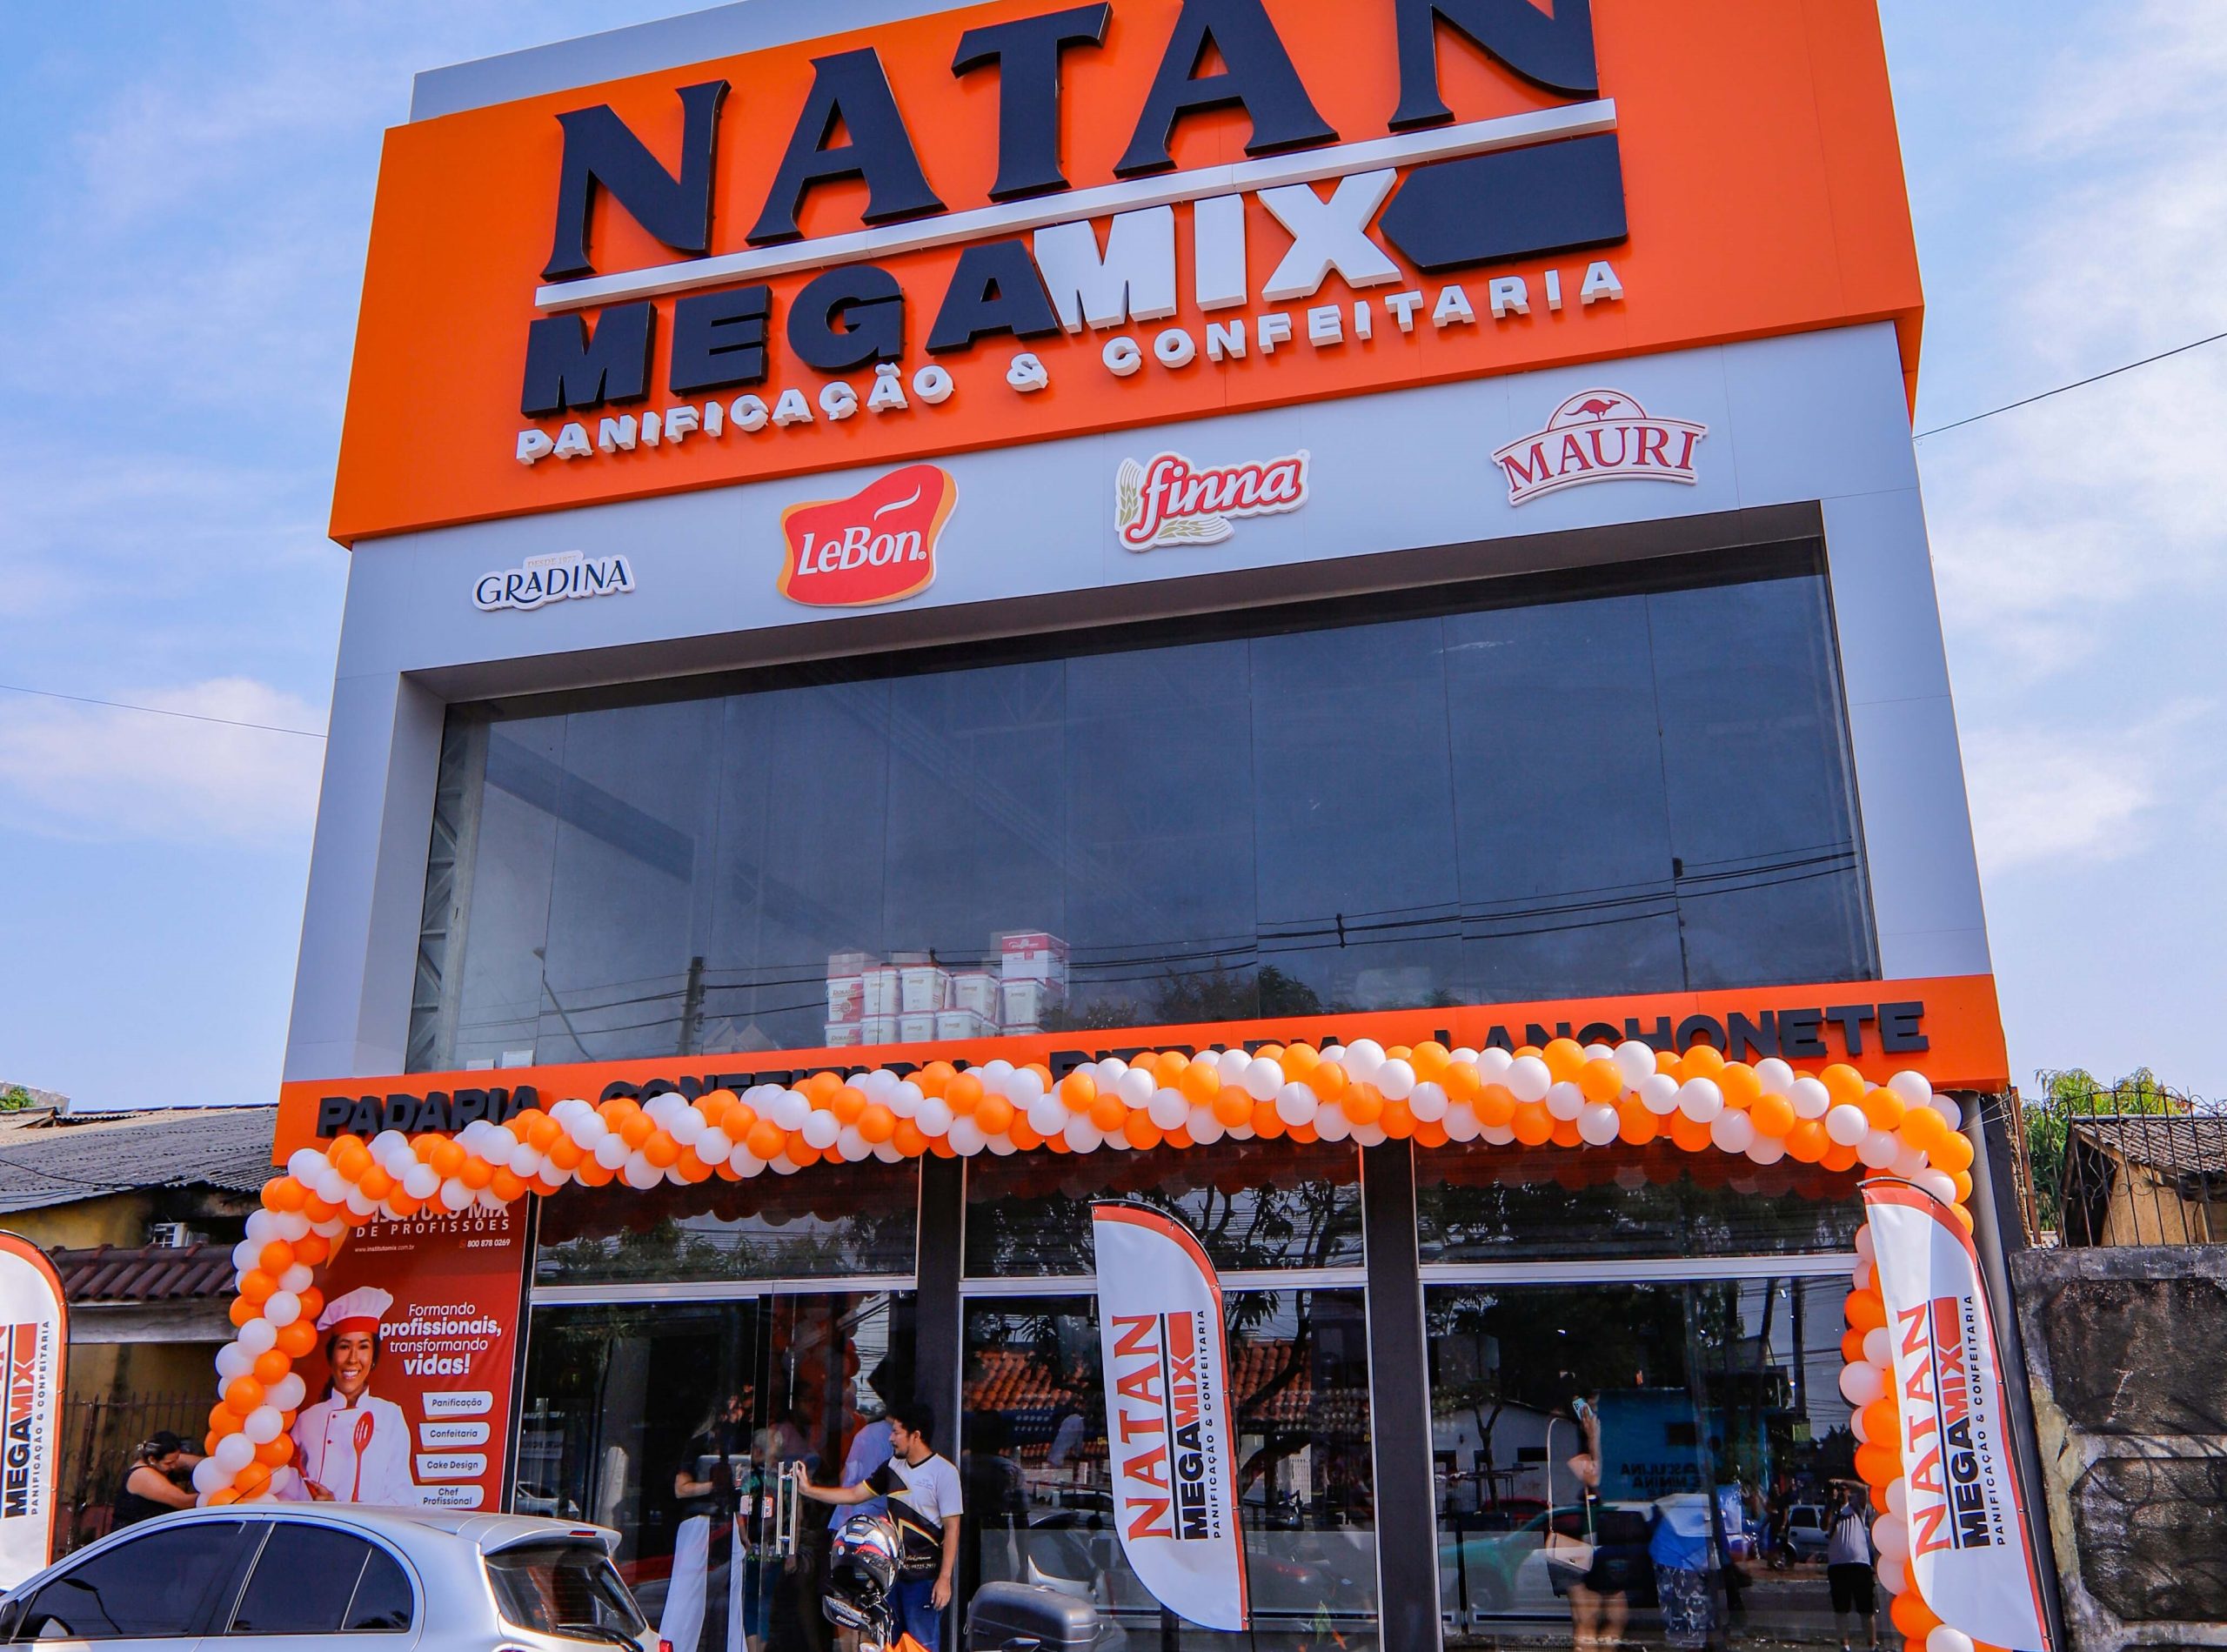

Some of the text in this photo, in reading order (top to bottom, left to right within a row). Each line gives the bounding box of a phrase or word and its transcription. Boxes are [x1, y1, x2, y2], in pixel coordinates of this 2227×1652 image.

[539, 0, 1601, 281] NATAN
[521, 168, 1402, 419] MEGAMIX
[517, 261, 1624, 465] PANIFICAÇÃO & CONFEITARIA
[1499, 426, 1700, 493] MAURI
[1128, 458, 1300, 540] finna
[527, 557, 557, 567] DESDE
[797, 526, 922, 576] LeBon
[476, 559, 628, 605] GRADINA
[1435, 1000, 1929, 1060] ANCHONETE
[317, 1085, 541, 1138] PADARIA
[356, 1218, 509, 1237] DE PROFISSÕES
[379, 1315, 502, 1341] profissionais,
[408, 1301, 476, 1317] Formando
[390, 1337, 488, 1352] transformando
[404, 1353, 471, 1375] vidas!
[30, 1427, 43, 1515] PANIFICAÇÃO
[37, 1321, 50, 1408] CONFEITARIA
[431, 1398, 482, 1408] Panificação
[1112, 1314, 1174, 1542] NATAN
[1197, 1310, 1221, 1539] PANIFICAÇÃO & CONFEITARIA
[1897, 1301, 1952, 1561] NATAN
[1963, 1295, 2006, 1546] PANIFICAÇÃO & CONFEITARIA
[3, 1360, 36, 1519] MEGAMIX
[430, 1428, 478, 1438] Confeitaria
[1171, 1355, 1208, 1541] MEGAMIX
[1938, 1345, 1991, 1548] MEGAMIX
[426, 1460, 478, 1471] Cake Design
[438, 1487, 459, 1496] Chef
[423, 1496, 472, 1506] Profissional
